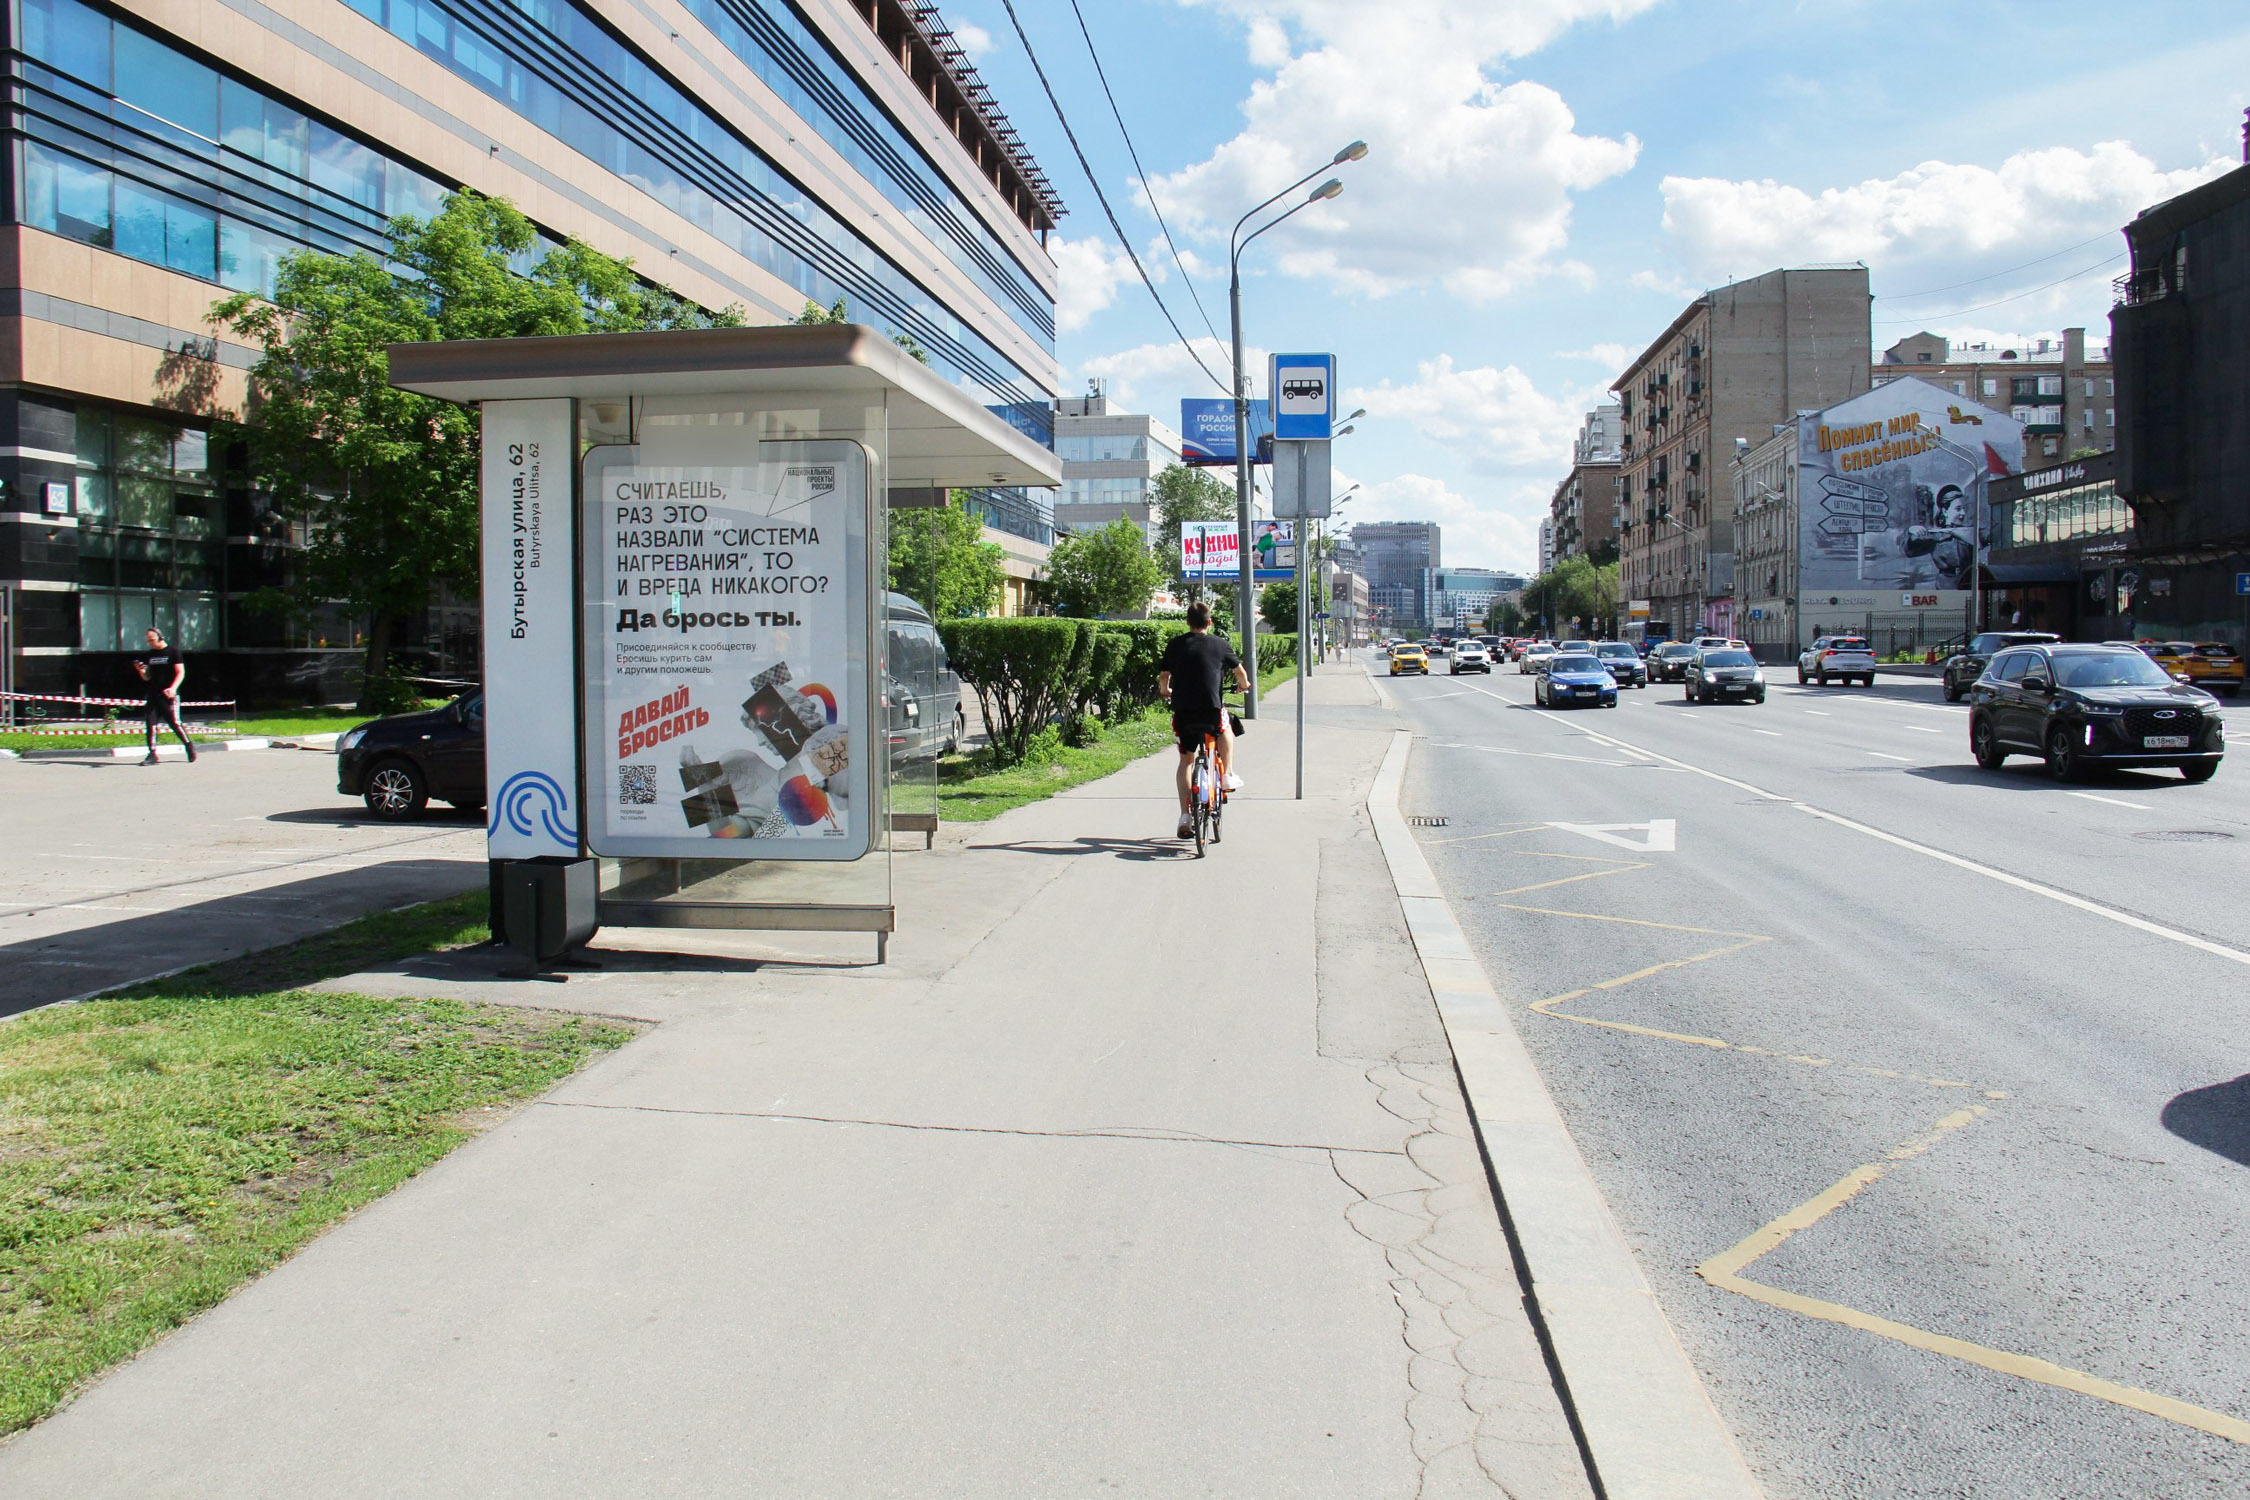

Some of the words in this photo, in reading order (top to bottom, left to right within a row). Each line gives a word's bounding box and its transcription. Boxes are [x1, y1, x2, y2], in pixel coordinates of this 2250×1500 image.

[1196, 414, 1235, 424] ГОРДОС
[1818, 421, 1883, 453] Помнит
[1888, 412, 1920, 436] мир
[509, 443, 524, 466] 62
[529, 443, 540, 458] 62
[529, 462, 540, 499] Ulitsa,
[788, 468, 833, 477] НАЦИОНАЛЬНЫЕ
[2023, 468, 2063, 491] ЧАЙХАНА
[616, 481, 727, 501] СЧИТАЕШЬ,
[811, 483, 833, 491] РОССИИ
[512, 472, 527, 533] улица,
[617, 506, 653, 524] РАЗ
[663, 505, 708, 523] ЭТО
[531, 502, 543, 568] Butyrskaya
[617, 529, 703, 548] НАЗВАЛИ
[763, 551, 794, 570] ТО
[1184, 550, 1239, 567] выоды!
[511, 538, 528, 639] Бутырская
[617, 578, 628, 596] И
[639, 577, 702, 598] ВРЕДА
[712, 575, 829, 595] НИКАКОГО?
[1912, 595, 1938, 606] BAR
[616, 609, 657, 632] Да
[662, 608, 750, 633] брось
[754, 611, 802, 627] ты.
[616, 642, 690, 653] Присоединяйся
[699, 642, 758, 652] сообществу.
[616, 654, 658, 664] Бросишь
[660, 655, 692, 664] курить
[624, 667, 658, 676] другим
[660, 666, 713, 674] поможешь.
[618, 684, 690, 737] ДАВАЙ
[618, 707, 709, 759] БРОСАТЬ
